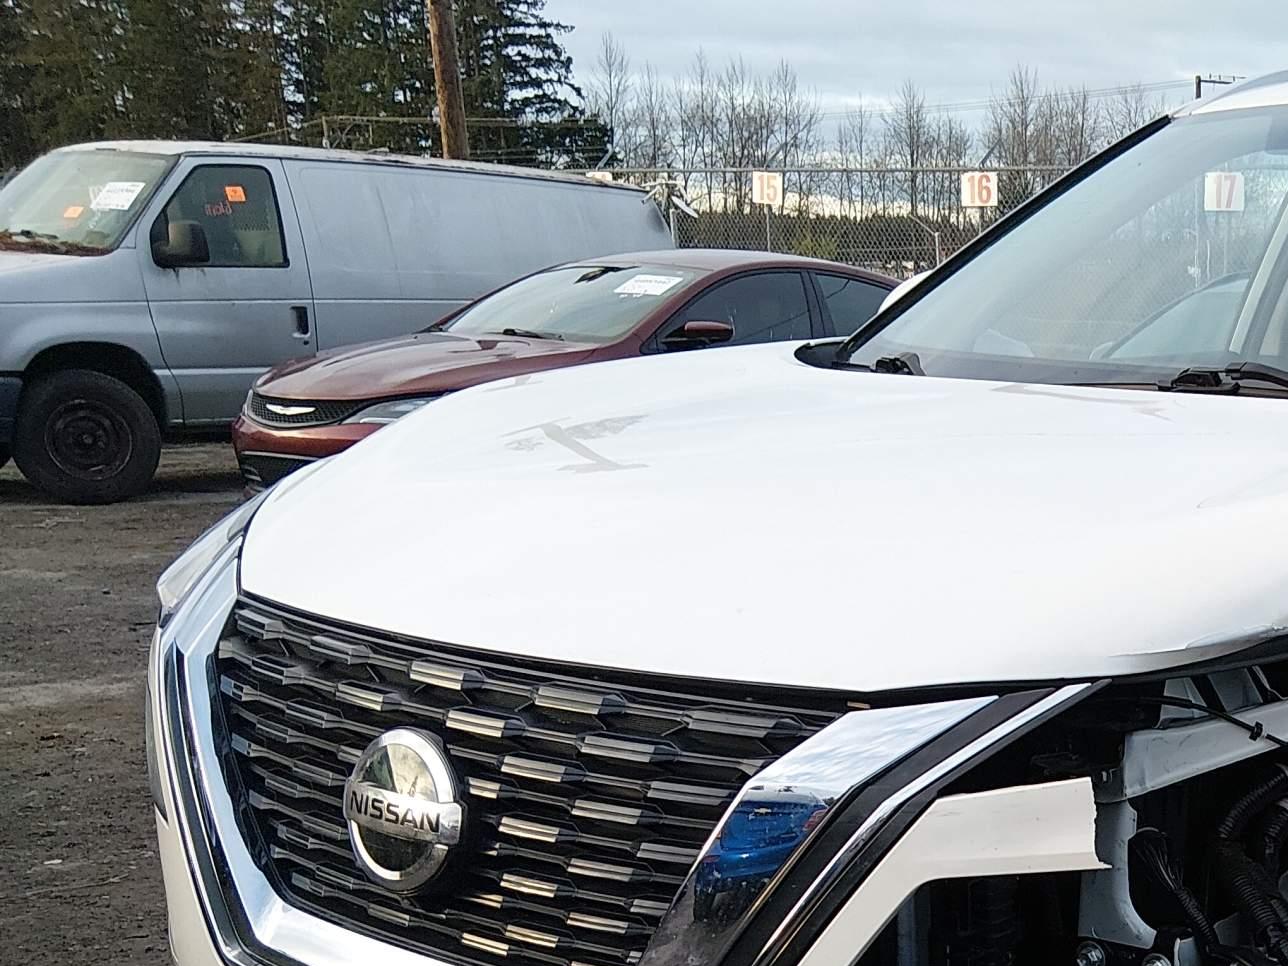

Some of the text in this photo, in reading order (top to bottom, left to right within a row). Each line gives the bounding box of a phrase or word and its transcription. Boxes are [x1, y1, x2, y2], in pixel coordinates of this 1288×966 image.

[758, 175, 777, 202] 15
[967, 174, 992, 204] 16
[1212, 175, 1238, 209] 17
[350, 790, 441, 833] NISSAN
